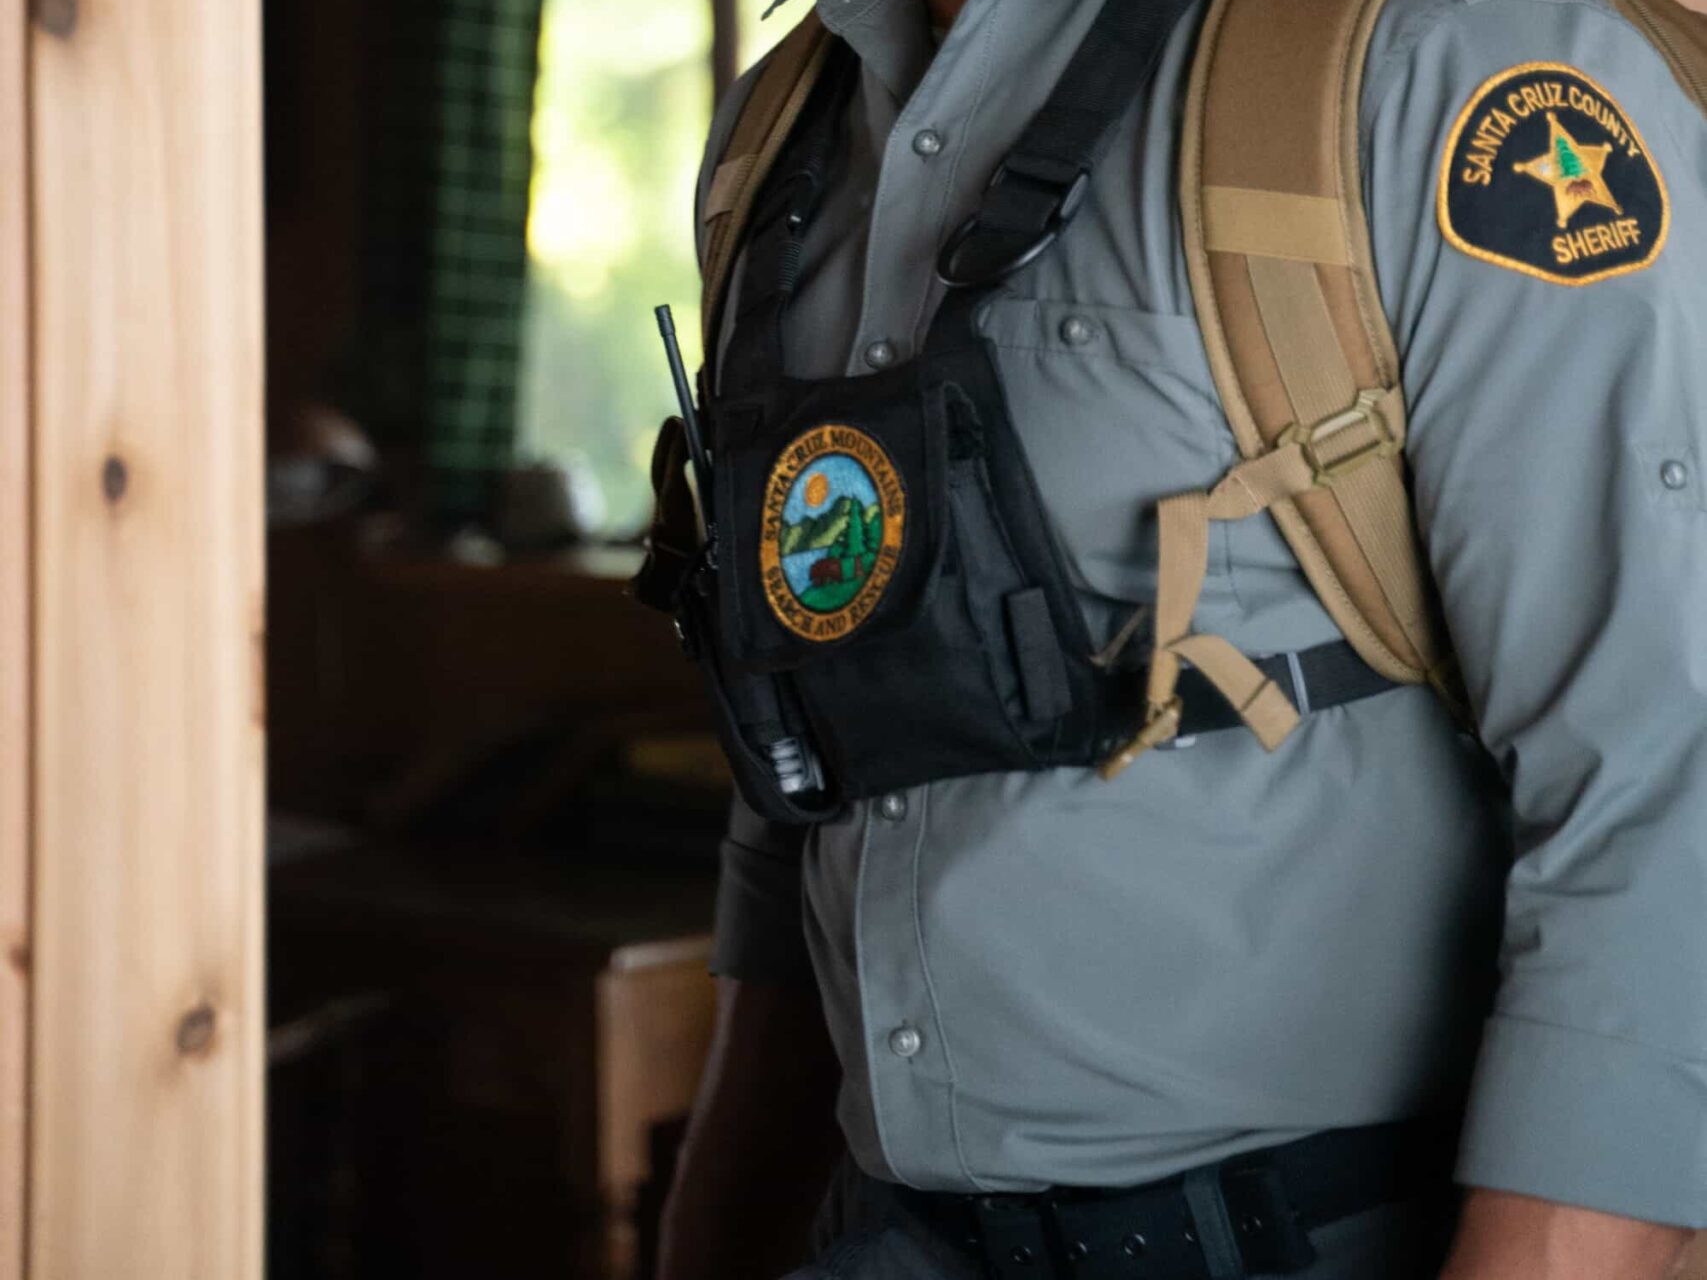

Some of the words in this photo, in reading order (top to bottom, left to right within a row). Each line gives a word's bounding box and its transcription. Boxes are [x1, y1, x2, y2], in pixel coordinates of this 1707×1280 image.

[1463, 108, 1518, 186] SANTA
[1507, 82, 1569, 118] CRUZ
[1569, 86, 1641, 157] COUNTY
[1552, 219, 1641, 264] SHERIFF
[764, 473, 792, 542] SANTA
[786, 431, 825, 472] CRUZ
[830, 429, 902, 518] MOUNTAINS
[767, 566, 813, 634] SEARCH
[815, 616, 848, 636] AND
[849, 546, 900, 624] RESCUE
